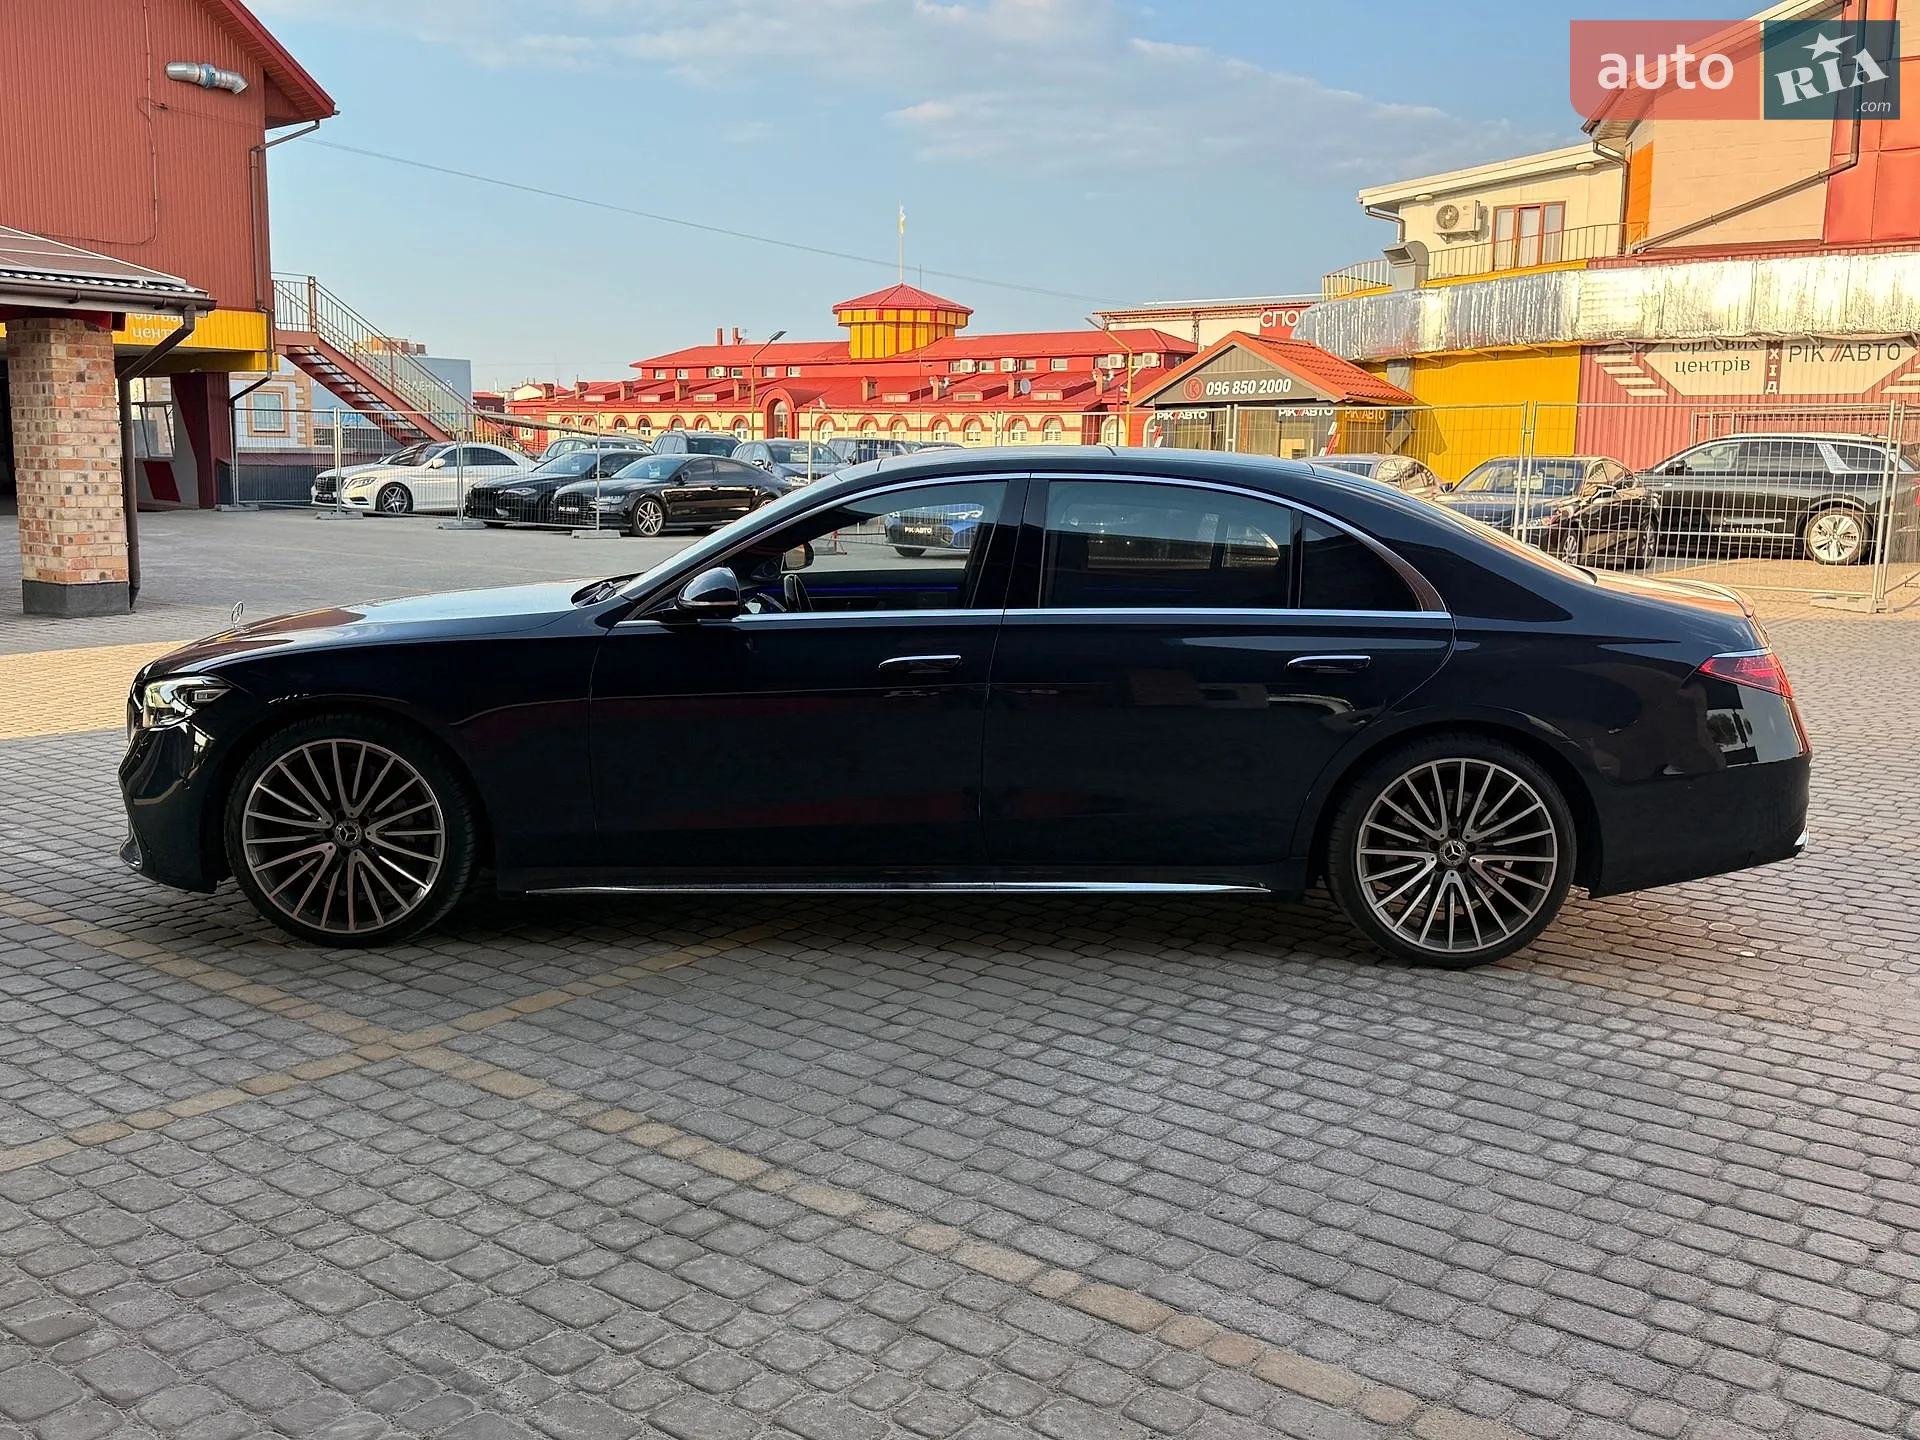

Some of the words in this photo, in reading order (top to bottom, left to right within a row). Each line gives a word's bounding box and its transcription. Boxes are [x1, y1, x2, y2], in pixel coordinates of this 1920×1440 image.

[1260, 309, 1305, 327] СПО
[1675, 356, 1751, 375] центрів
[1764, 342, 1781, 394] ХІД
[1205, 381, 1229, 396] 096
[1231, 379, 1257, 395] 850
[1259, 378, 1292, 394] 2000
